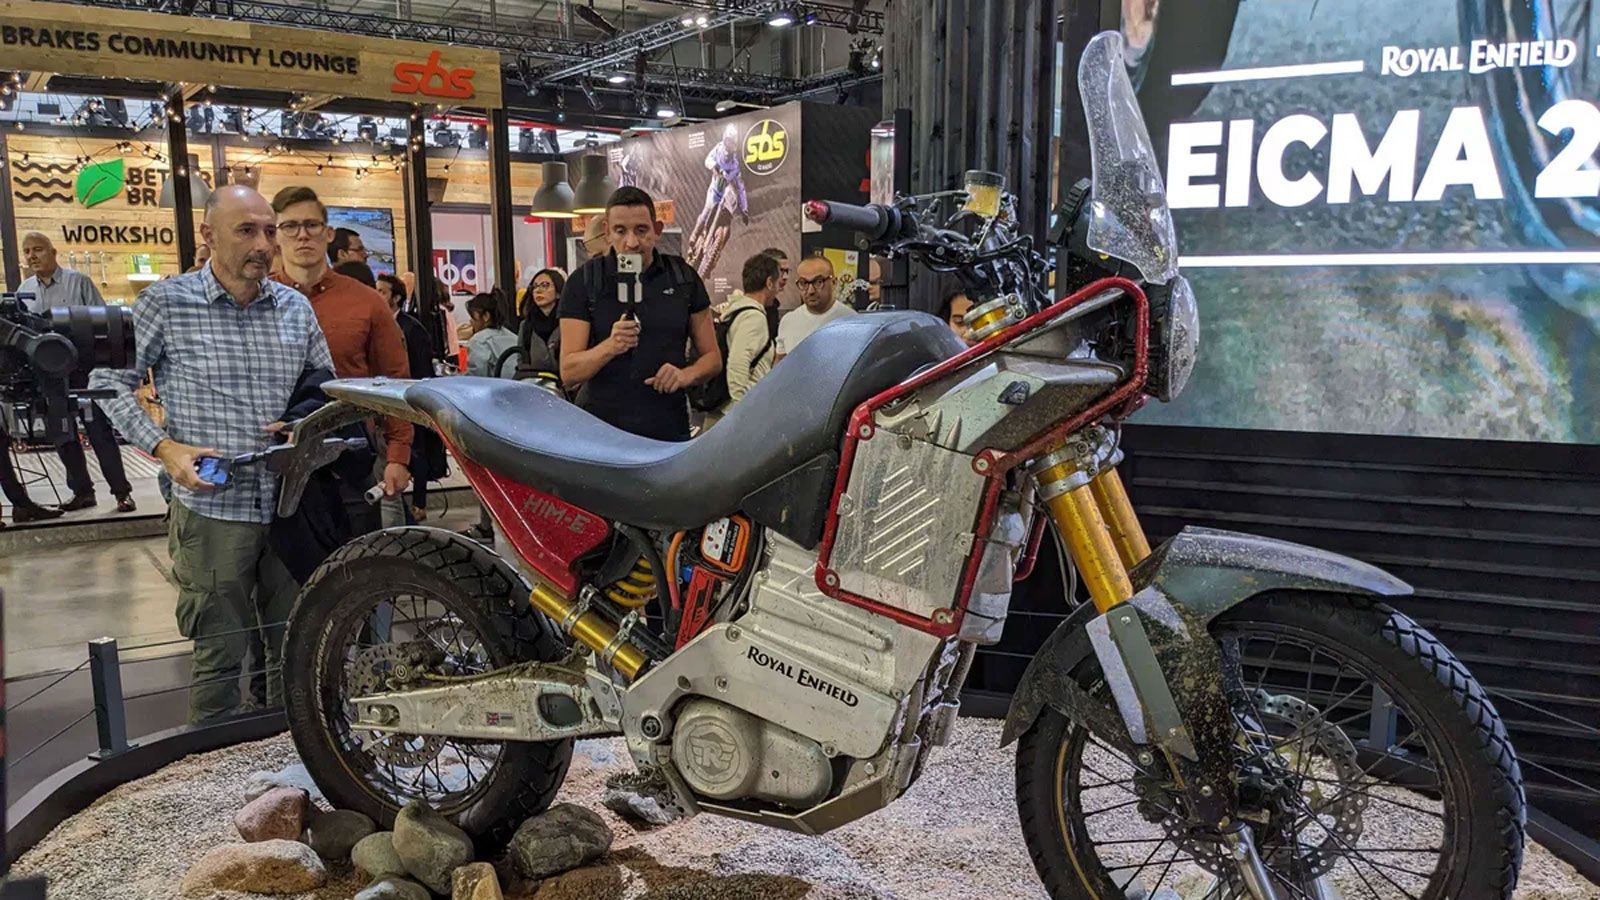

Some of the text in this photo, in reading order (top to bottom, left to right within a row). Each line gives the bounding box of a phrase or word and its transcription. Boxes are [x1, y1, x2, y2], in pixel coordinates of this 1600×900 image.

[1, 25, 360, 75] BRAKES COMMUNITY LOUNGE
[1381, 39, 1577, 77] ROYAL ENFIELD
[391, 51, 476, 99] sbs
[745, 119, 785, 164] sbs
[1166, 105, 1504, 209] EICMA
[62, 225, 174, 245] WORKSHO
[521, 493, 592, 535] HIM-E
[747, 645, 859, 707] ROYAL ENFIELD
